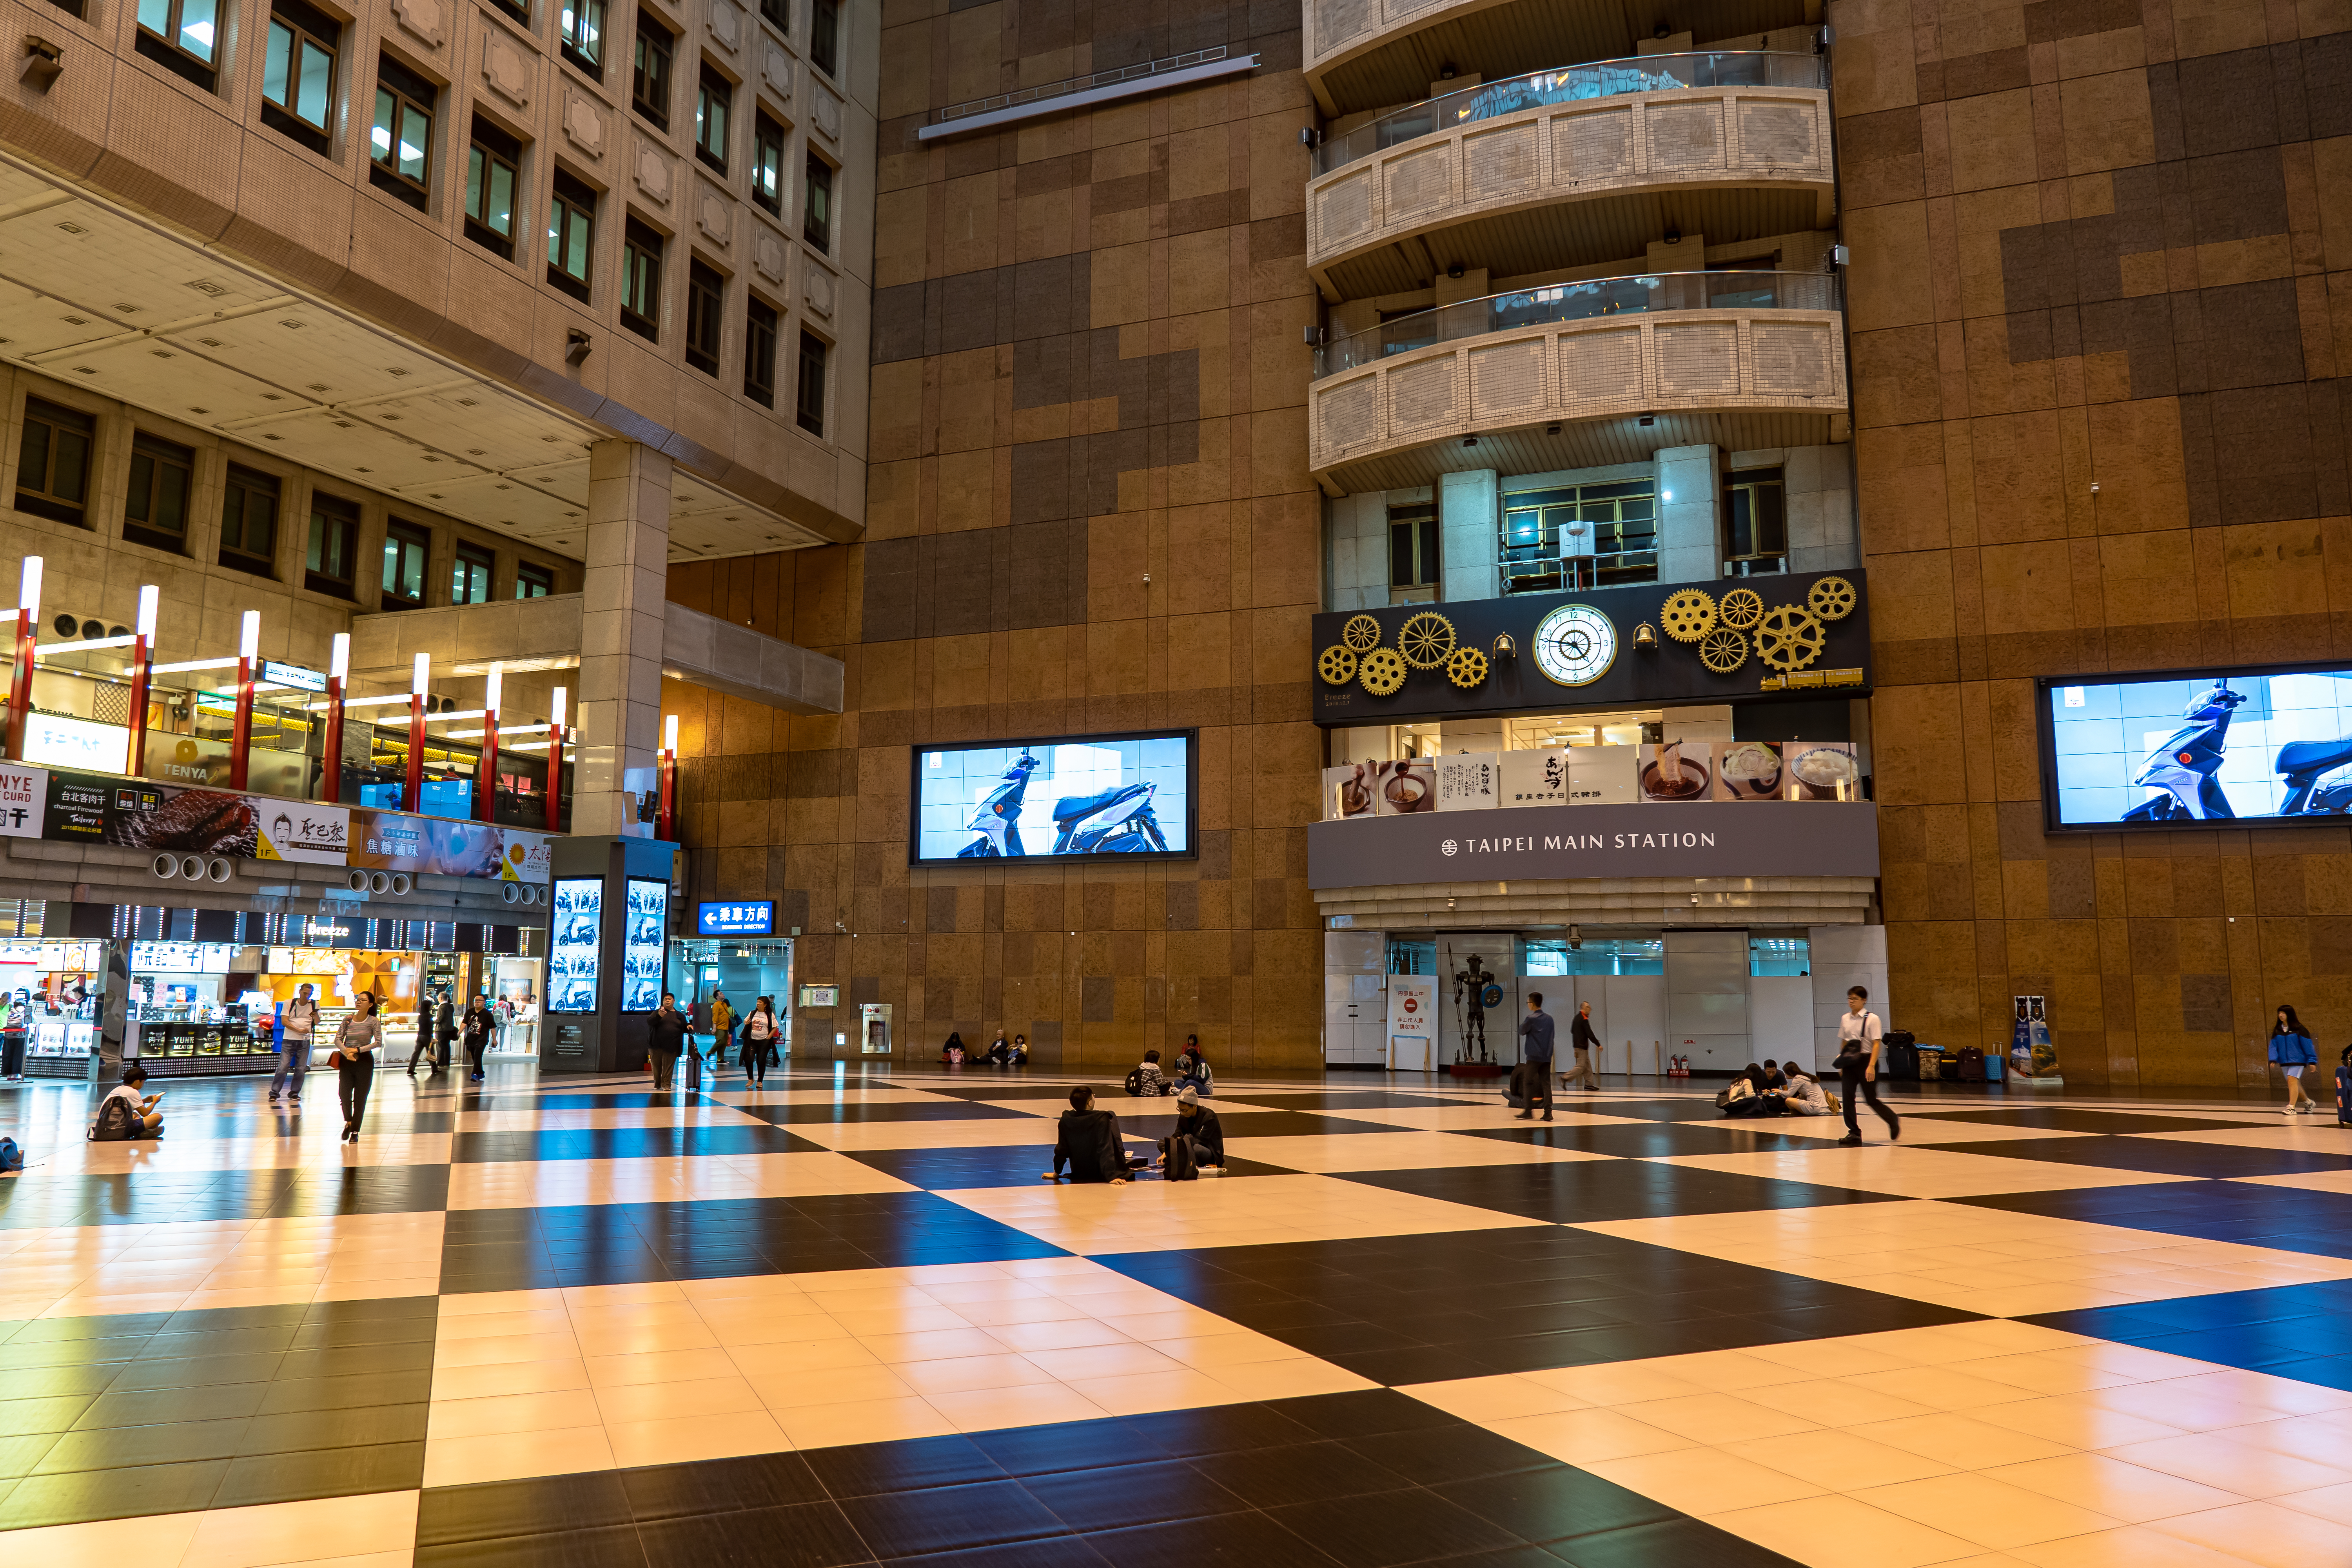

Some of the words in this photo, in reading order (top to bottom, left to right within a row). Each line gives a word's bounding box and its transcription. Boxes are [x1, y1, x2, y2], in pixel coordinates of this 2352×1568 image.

[163, 764, 207, 780] TENYA
[4, 791, 31, 802] CURD
[61, 791, 106, 805] 台北客肉干
[143, 795, 155, 803] 黑豆
[366, 838, 419, 857] 焦糖滷味
[1466, 837, 1532, 853] TAIPEI
[1544, 835, 1603, 850] MAIN
[1615, 833, 1715, 848] STATION
[720, 906, 768, 922] 乘車方向
[308, 923, 349, 936] Breeze
